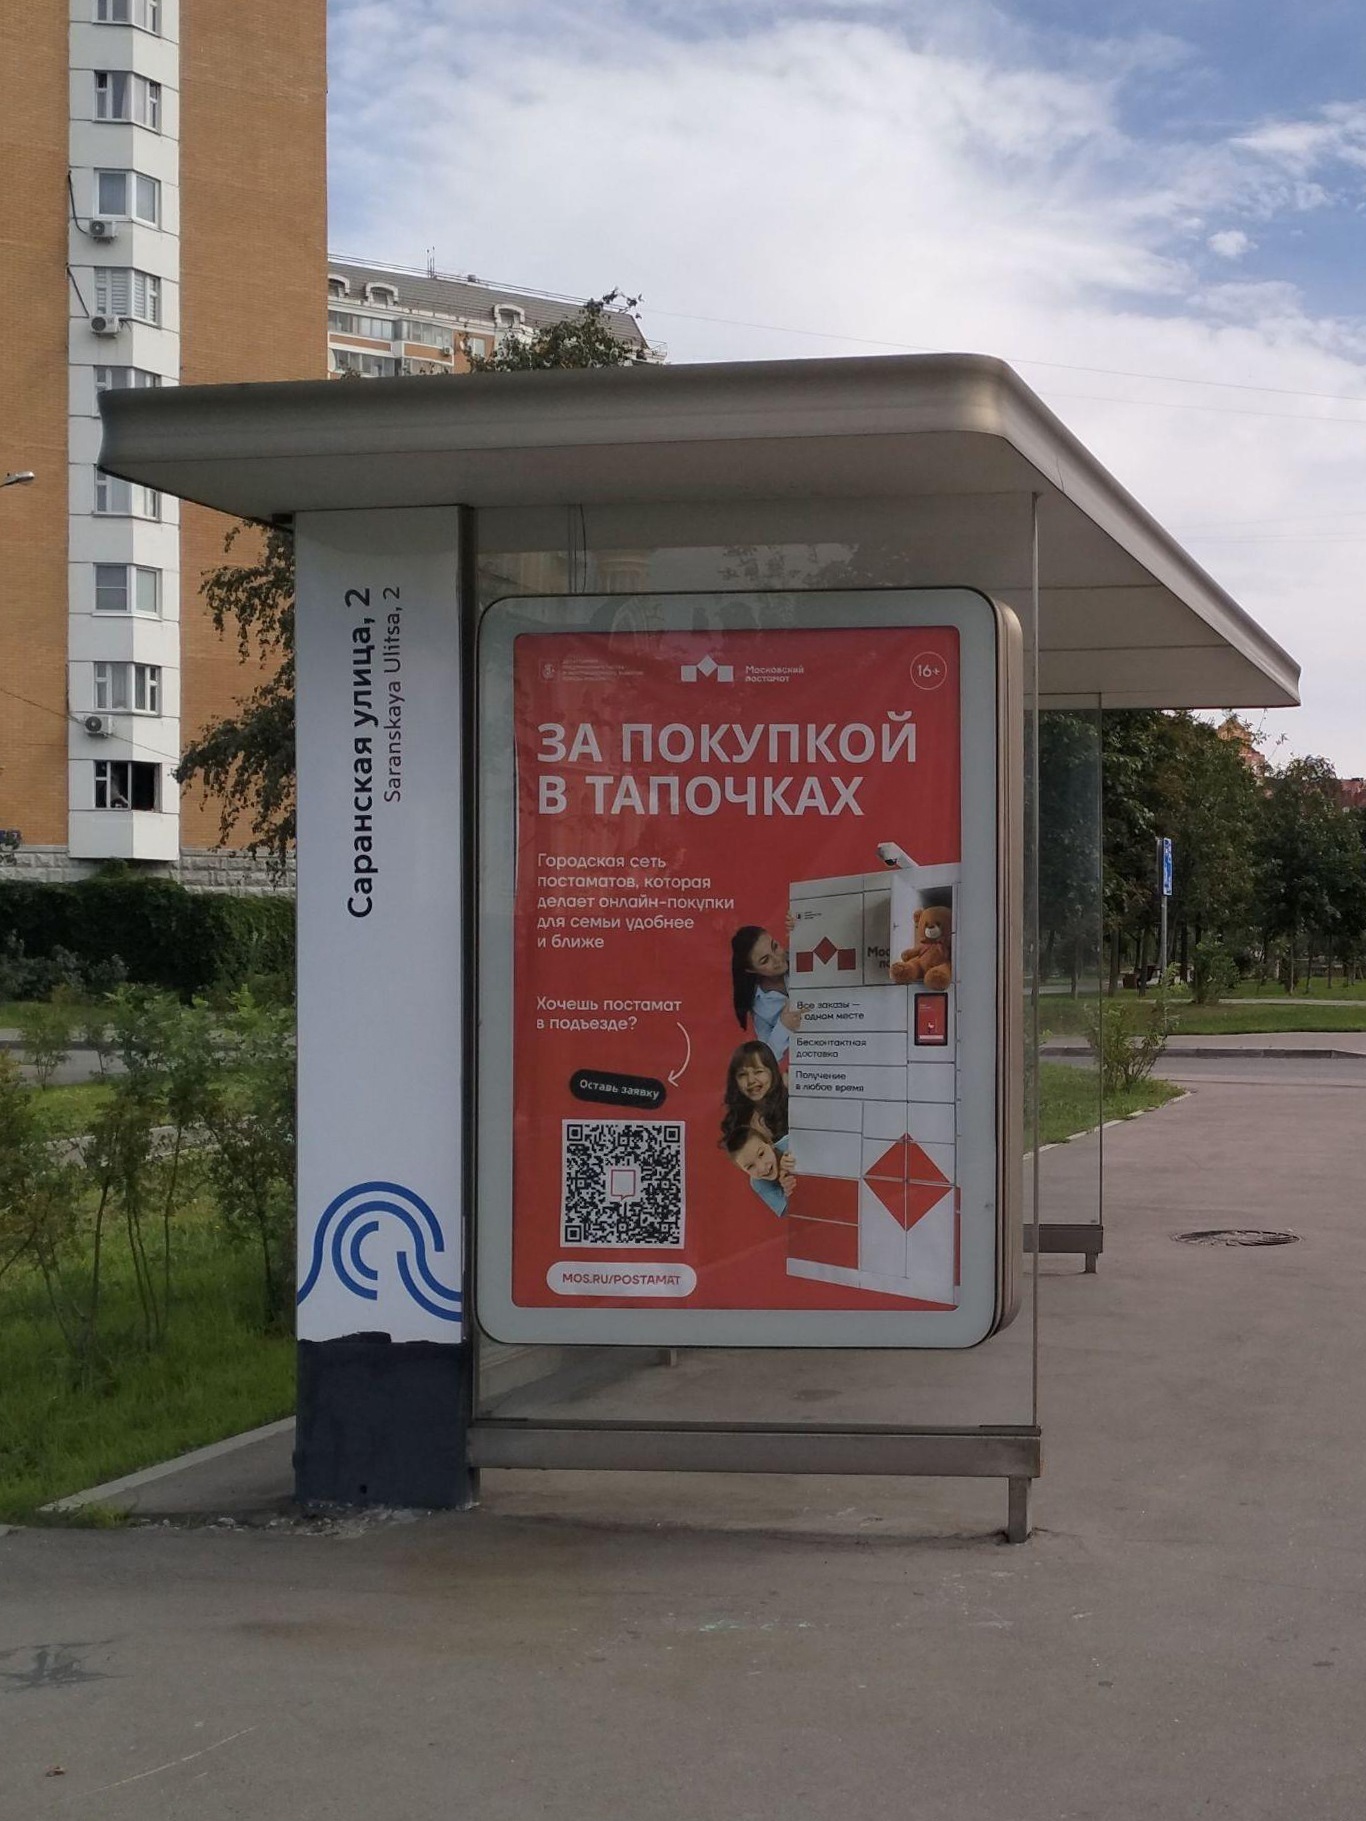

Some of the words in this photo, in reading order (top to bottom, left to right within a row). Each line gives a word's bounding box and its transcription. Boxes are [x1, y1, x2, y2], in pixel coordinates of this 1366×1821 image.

[345, 587, 371, 607] 2
[383, 586, 400, 600] 2
[383, 605, 403, 674] Ulitsa,
[352, 616, 378, 728] улица,
[918, 664, 941, 678] 16+
[383, 681, 405, 802] Saranskaya
[537, 723, 603, 763] ЗА
[622, 710, 917, 763] ПОКУПКОЙ
[538, 775, 567, 815] В
[585, 775, 864, 816] ТАПОЧКАХ
[347, 737, 378, 918] Саранская
[537, 853, 625, 870] Городская
[630, 857, 666, 869] сеть
[537, 876, 639, 889] постаматов,
[644, 876, 711, 891] которая
[537, 896, 595, 909] делает
[599, 894, 734, 911] онлайн-покупки
[537, 917, 565, 930] для
[570, 918, 621, 929] семьи
[626, 915, 695, 931] удобнее
[537, 937, 546, 948] и
[551, 934, 604, 949] ближе
[536, 996, 599, 1011] Хочешь
[603, 999, 682, 1012] постамат
[796, 1001, 815, 1010] Все
[817, 1001, 850, 1009] заказы
[536, 1018, 545, 1029] в
[550, 1016, 638, 1031] подъезде?
[796, 1037, 867, 1047] Бесконтактная
[796, 1050, 839, 1059] доставка
[795, 1070, 847, 1081] Получение
[579, 1079, 619, 1093] Оставь
[621, 1087, 660, 1100] заявку
[562, 1273, 682, 1286] MOS.RU/POSTAMAT
